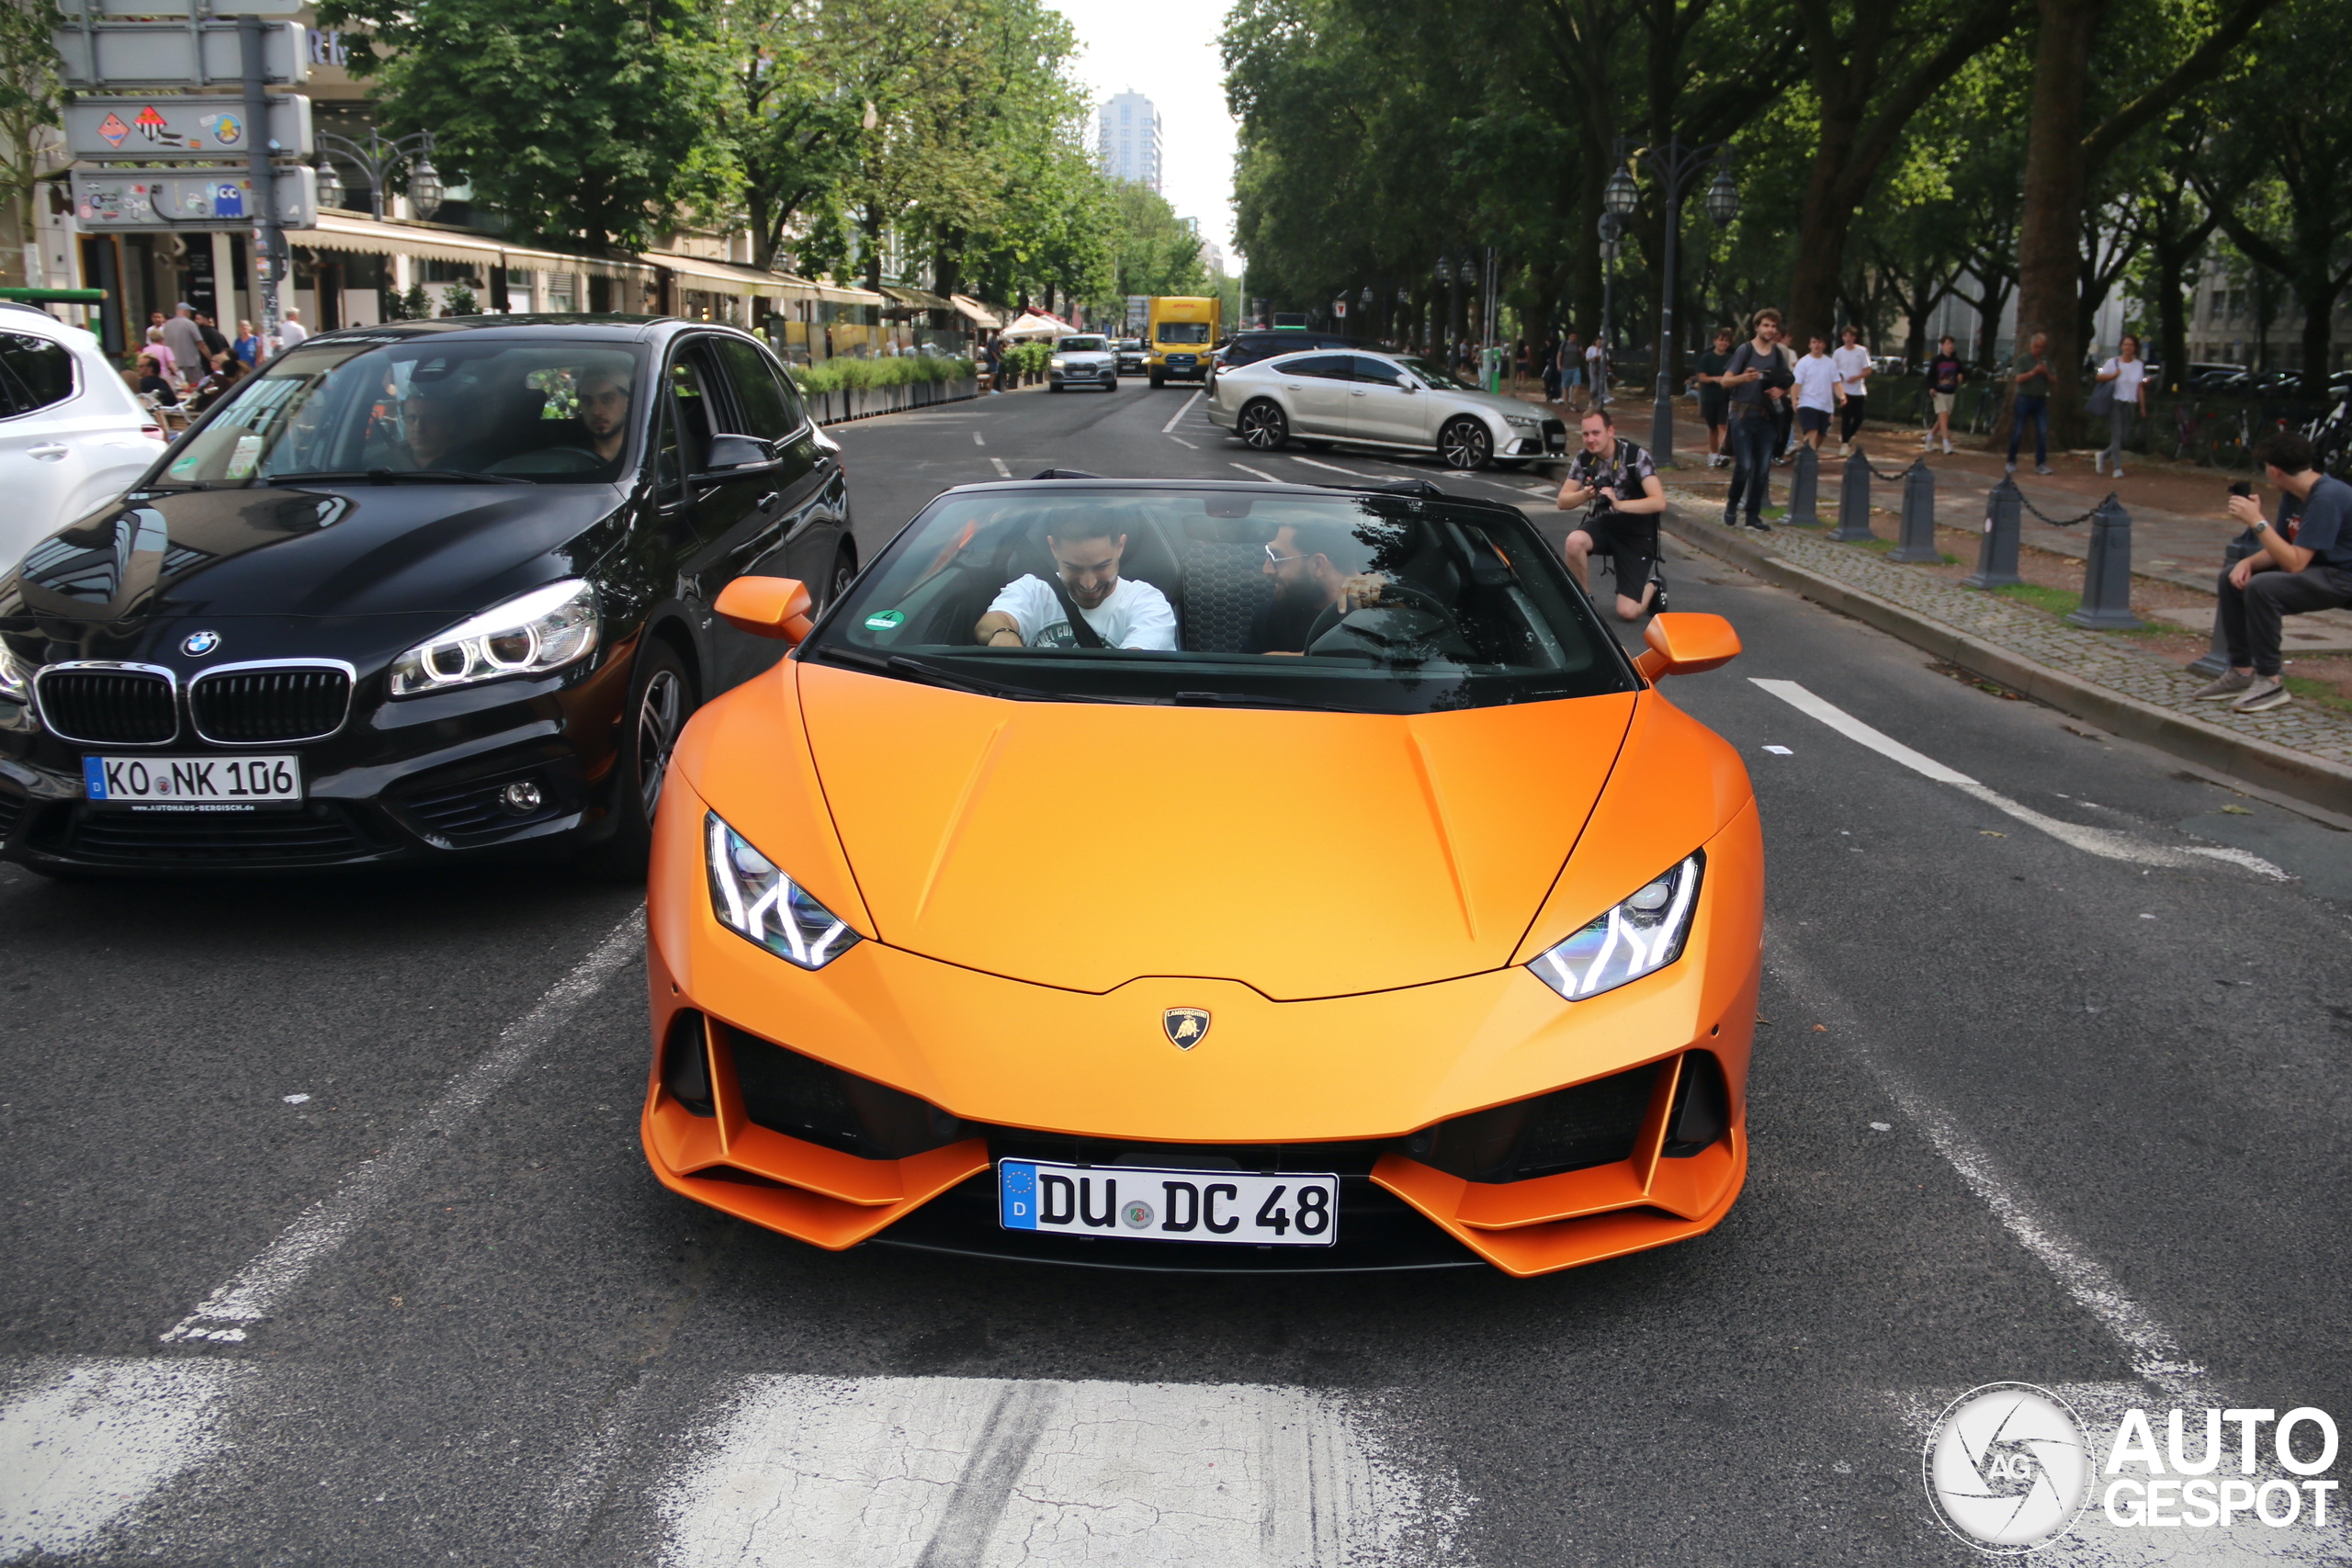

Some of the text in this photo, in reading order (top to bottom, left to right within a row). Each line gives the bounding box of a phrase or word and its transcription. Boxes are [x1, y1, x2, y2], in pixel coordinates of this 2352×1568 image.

[882, 611, 896, 620] 4
[105, 761, 294, 795] KO NK 106
[93, 783, 102, 792] D
[1167, 1010, 1207, 1020] LAMBORGHINI
[1013, 1201, 1027, 1217] D
[1038, 1173, 1329, 1236] DU DC 48
